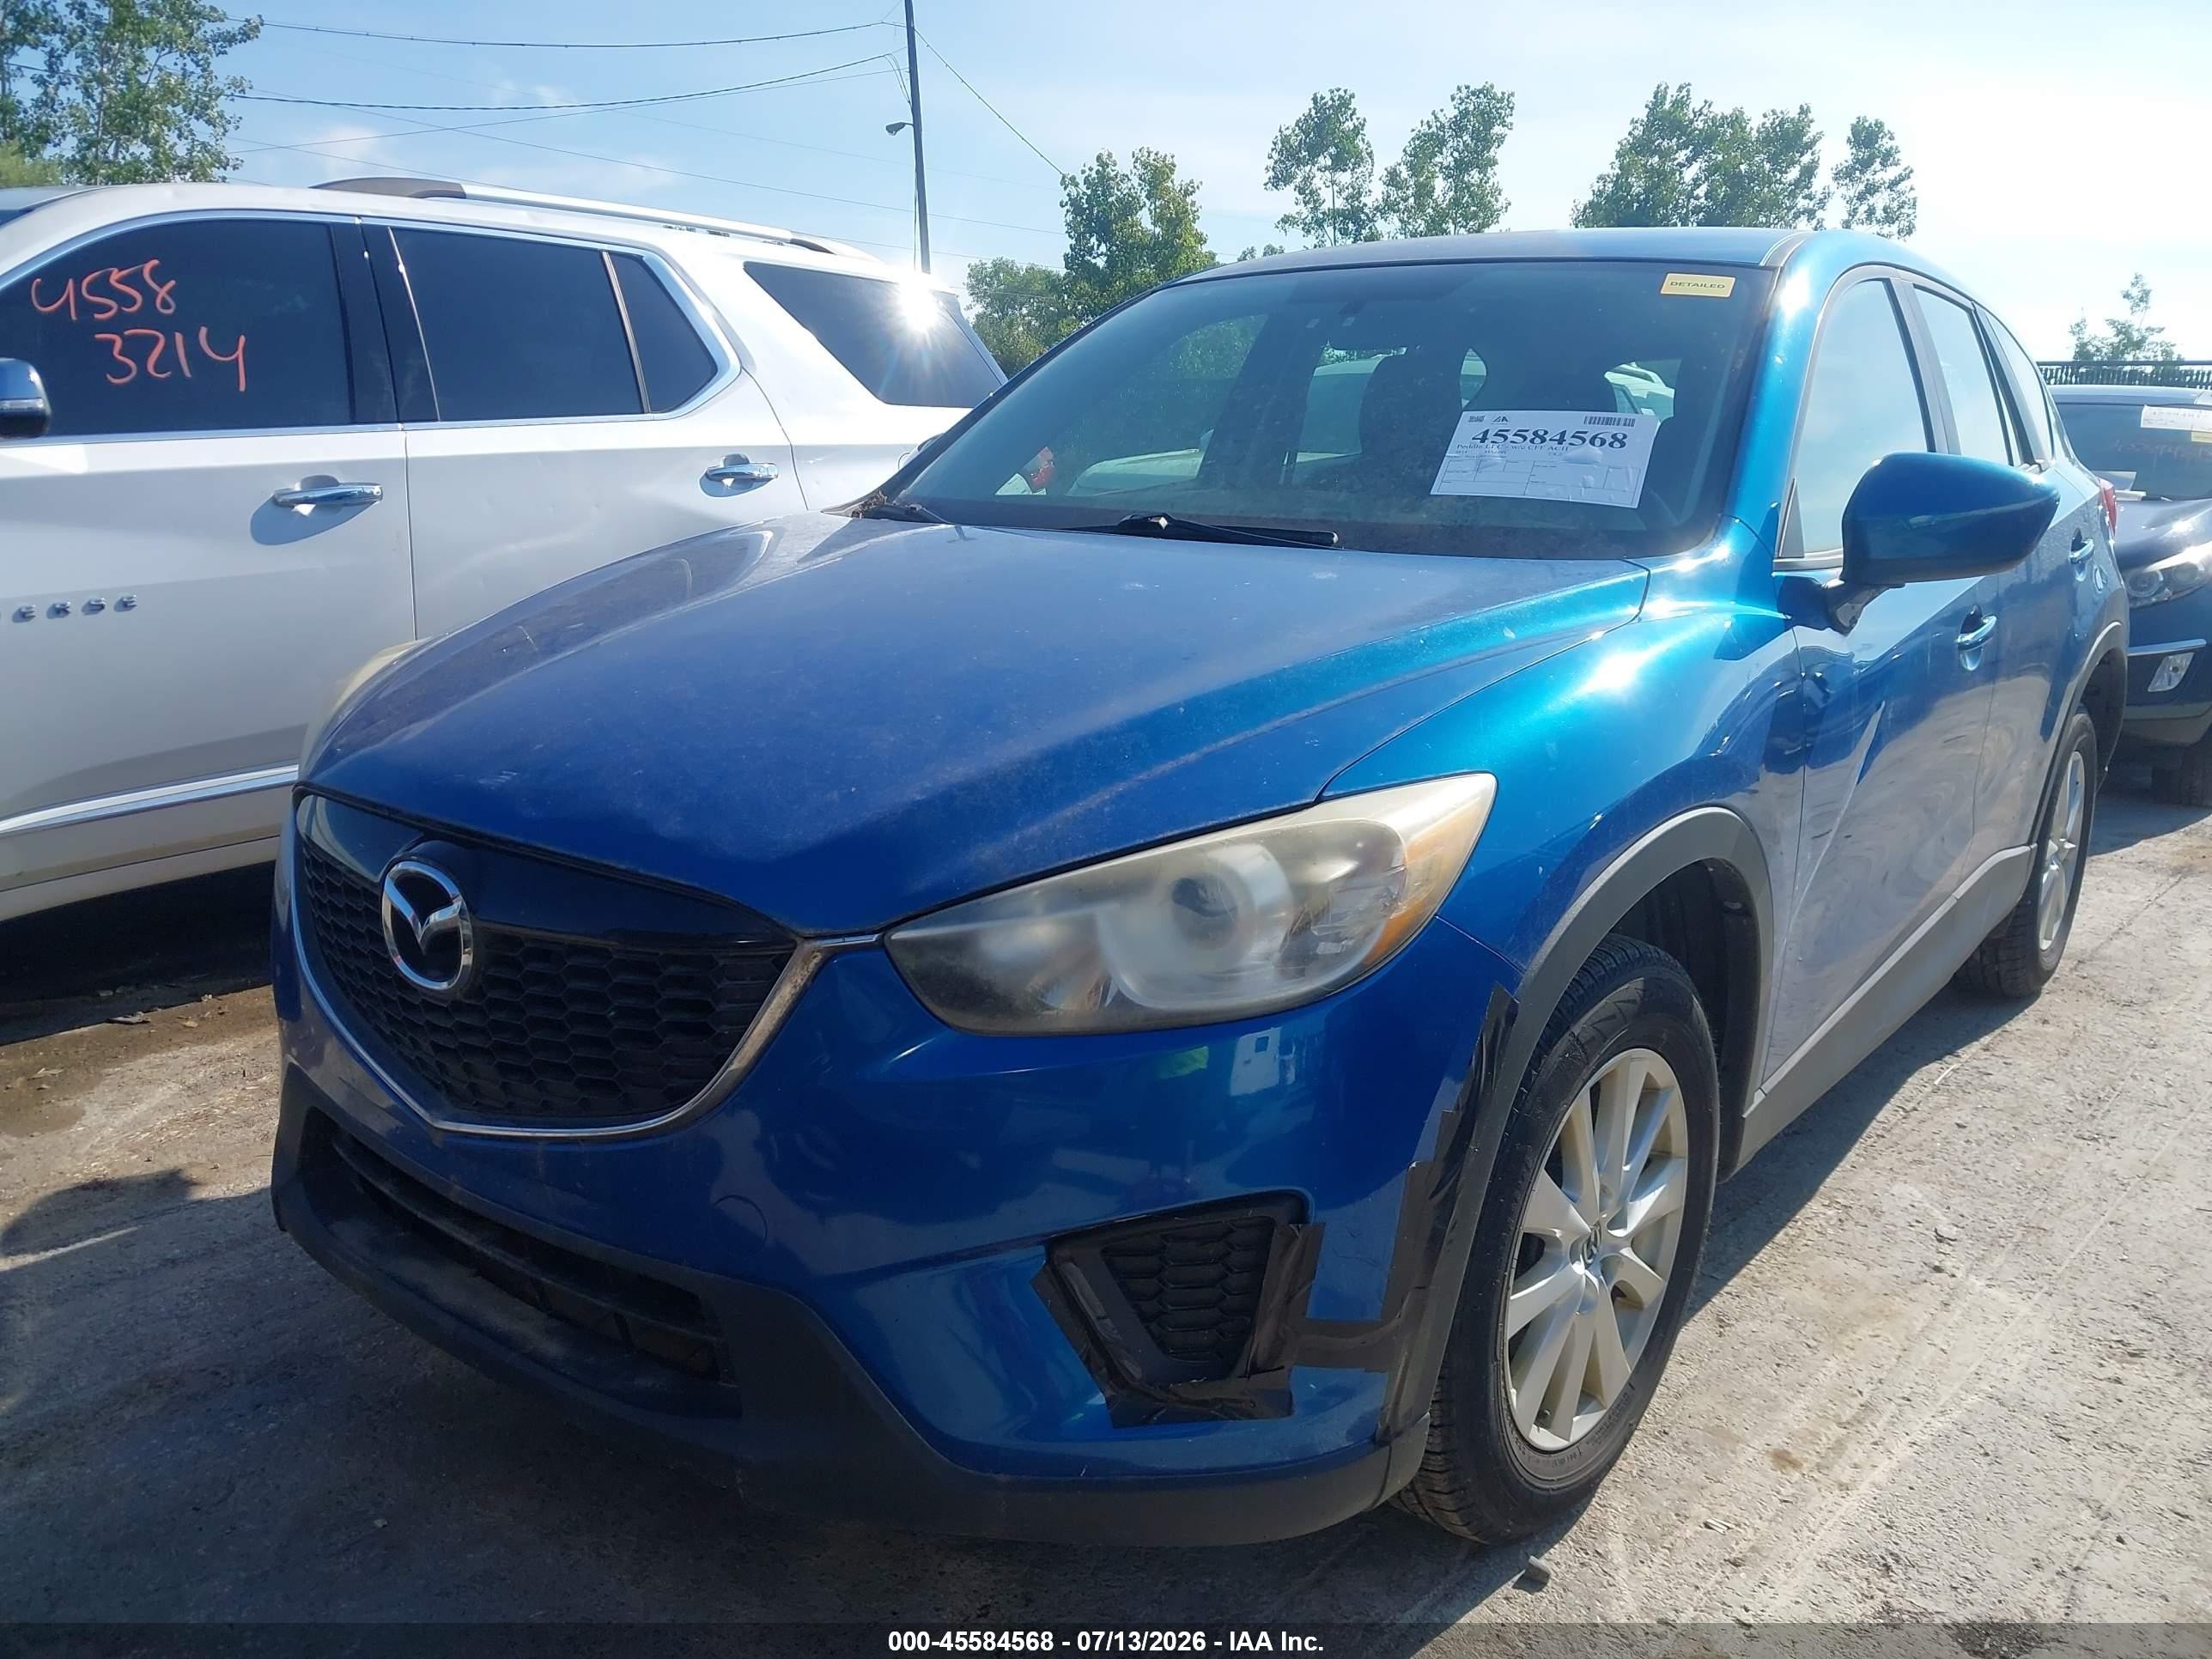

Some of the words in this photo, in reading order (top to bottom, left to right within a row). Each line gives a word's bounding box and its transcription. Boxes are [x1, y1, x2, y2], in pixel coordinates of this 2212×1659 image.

[31, 258, 177, 320] 4558
[1669, 281, 1725, 289] DETAILED
[94, 325, 246, 392] 3214
[1471, 428, 1628, 449] 45584568
